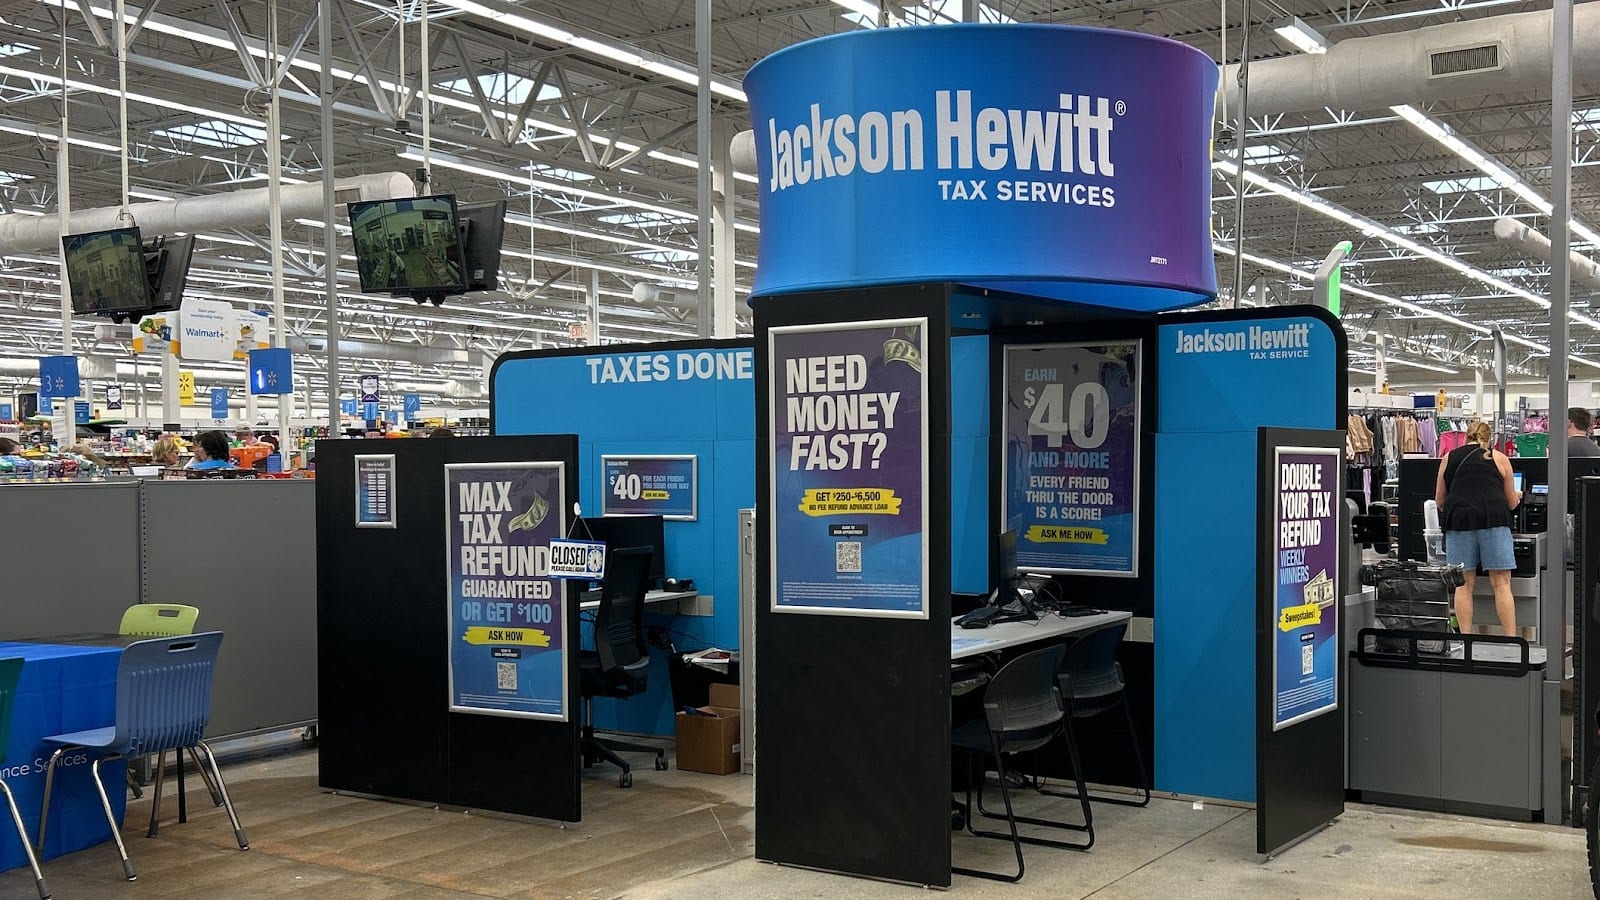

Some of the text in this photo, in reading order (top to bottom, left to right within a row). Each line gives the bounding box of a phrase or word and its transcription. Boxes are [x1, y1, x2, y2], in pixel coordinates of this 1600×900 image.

[768, 102, 923, 193] Jackson
[938, 180, 1115, 208] TAX SERVICES
[1175, 323, 1309, 354] Jackson Hewitt
[1250, 350, 1309, 360] TAX SERVICE
[586, 351, 753, 384] TAXES DONE
[786, 354, 868, 394] NEED
[1024, 368, 1057, 381] EARN
[46, 375, 52, 393] 3
[255, 369, 264, 390] 1
[787, 391, 901, 433] MONEY
[1023, 382, 1110, 449] $40
[790, 432, 888, 471] FAST?
[1028, 451, 1110, 469] AND MORE
[609, 474, 641, 500] $40
[1030, 475, 1110, 490] EVERY FRIEND
[1281, 463, 1322, 491] DOUBLE
[459, 481, 512, 512] MAX
[816, 492, 831, 502] GET
[1025, 490, 1114, 505] THRU THE DOOR
[1280, 491, 1331, 520] YOUR TAX
[1035, 506, 1102, 520] IS A SCORE!
[459, 513, 503, 544] TAX
[1041, 529, 1093, 540] ASK ME HOW
[1280, 519, 1321, 549] REFUND
[461, 545, 550, 577] REFUND
[551, 545, 586, 566] CLOSED
[1280, 548, 1306, 568] WEEKLY
[1280, 565, 1310, 585] WINNERS
[461, 579, 552, 600] GUARANTEED
[461, 601, 552, 624] OR GET $100
[1285, 609, 1315, 624] Sweepstakes!
[488, 630, 524, 641] ASK HOW
[0, 764, 30, 779] nce
